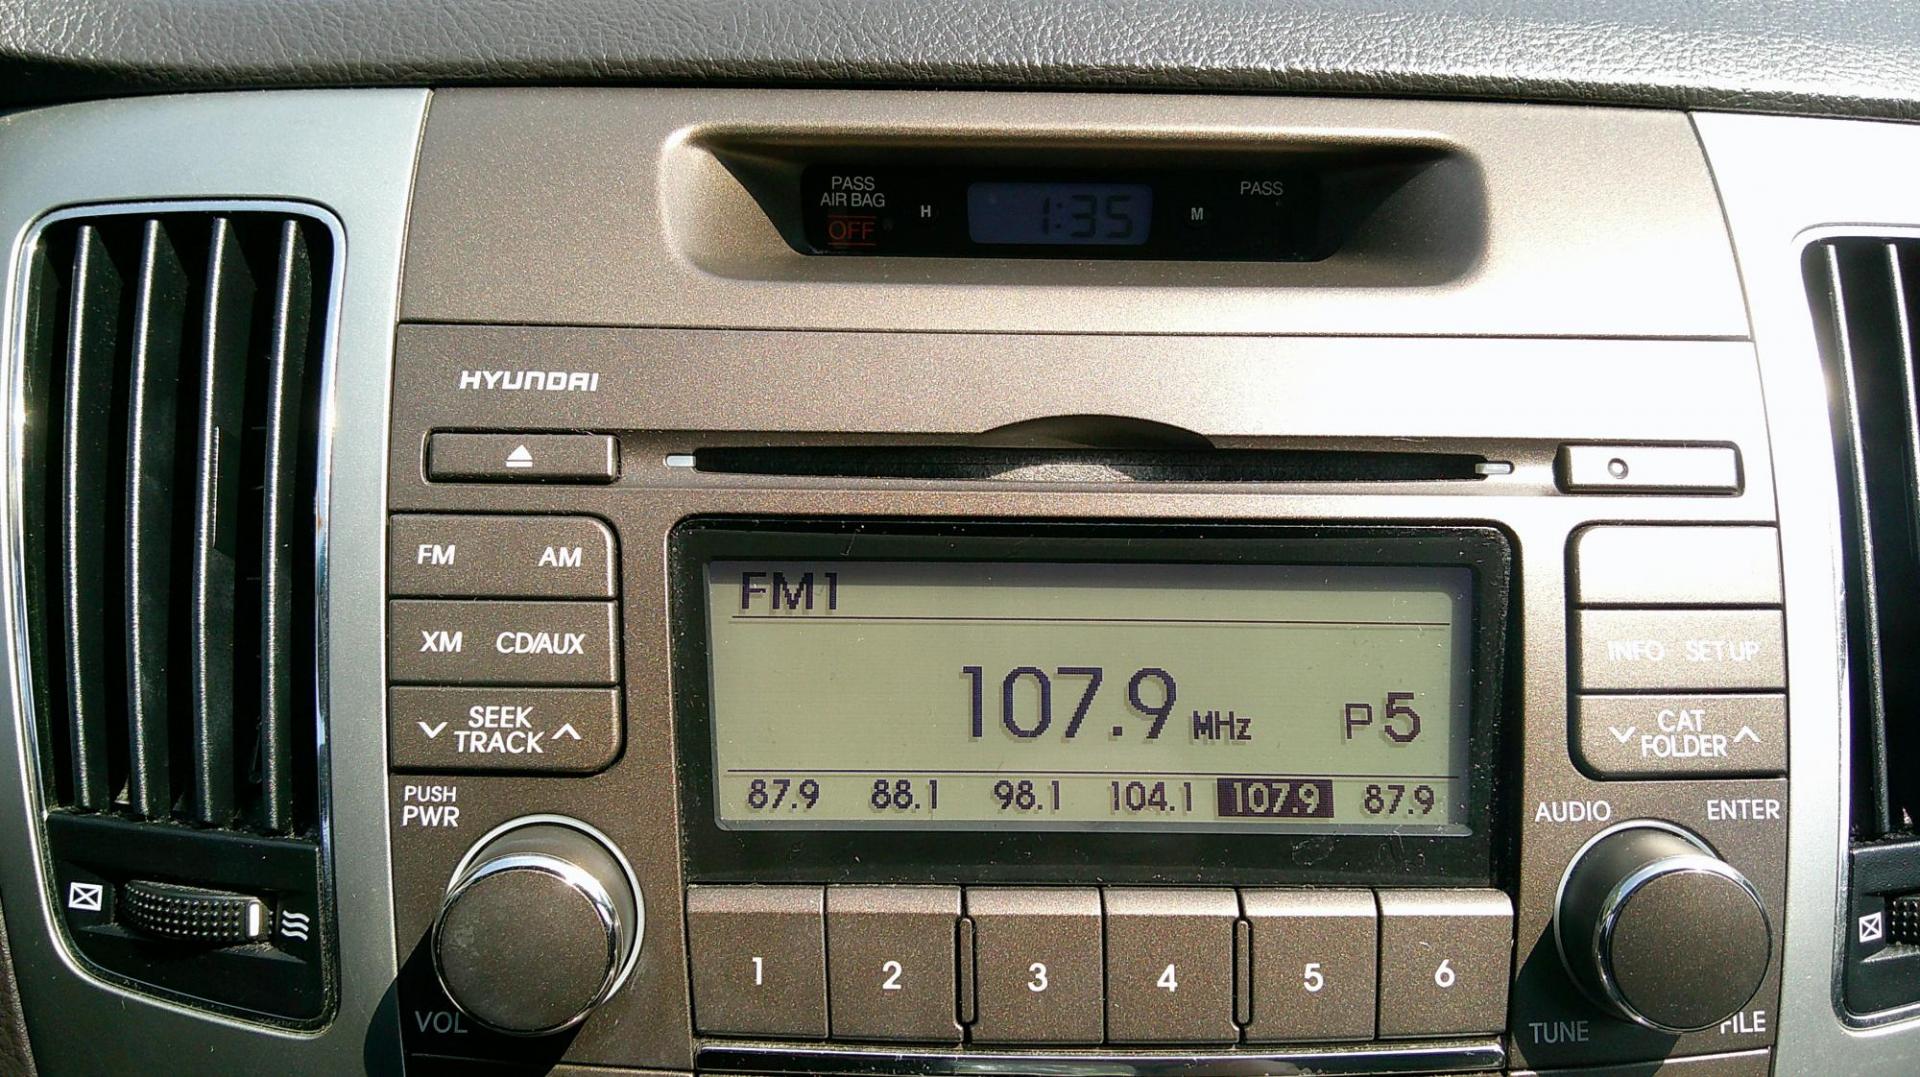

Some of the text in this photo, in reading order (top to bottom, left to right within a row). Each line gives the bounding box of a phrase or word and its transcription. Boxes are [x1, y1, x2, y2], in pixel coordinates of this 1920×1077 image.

[830, 175, 876, 192] PASS
[1240, 180, 1284, 197] PASS
[820, 192, 885, 208] AIR BAG
[920, 203, 932, 219] H
[1041, 194, 1134, 240] 1:35
[1190, 207, 1204, 222] M
[827, 220, 877, 241] OFF
[459, 370, 599, 392] HYUNDAI
[417, 543, 456, 566] FM
[538, 546, 582, 568] AM
[738, 571, 840, 612] FM1
[419, 630, 463, 653] XM
[496, 631, 586, 655] CD/AUX
[1607, 640, 1666, 662] INFO
[961, 664, 1178, 741] 107.9
[468, 705, 534, 729] SEEK
[1193, 711, 1253, 742] MHz
[1657, 708, 1706, 733] CAT
[454, 730, 545, 754] TRACK
[1641, 734, 1728, 758] FOLDER
[404, 785, 457, 802] PUSH
[747, 778, 1435, 817] 87.9 88.1 98.1 104.1 107.9 87.9
[402, 805, 460, 828] PWR
[1534, 800, 1612, 823] AUDIO
[1707, 799, 1781, 820] ENTER
[753, 956, 763, 987] 1
[882, 959, 903, 990] 2
[1027, 962, 1049, 994] 3
[1156, 962, 1179, 993] 4
[1303, 962, 1325, 993] 5
[1434, 958, 1456, 989] 6
[415, 1011, 468, 1033] VOL
[1528, 1020, 1590, 1044] TUNE
